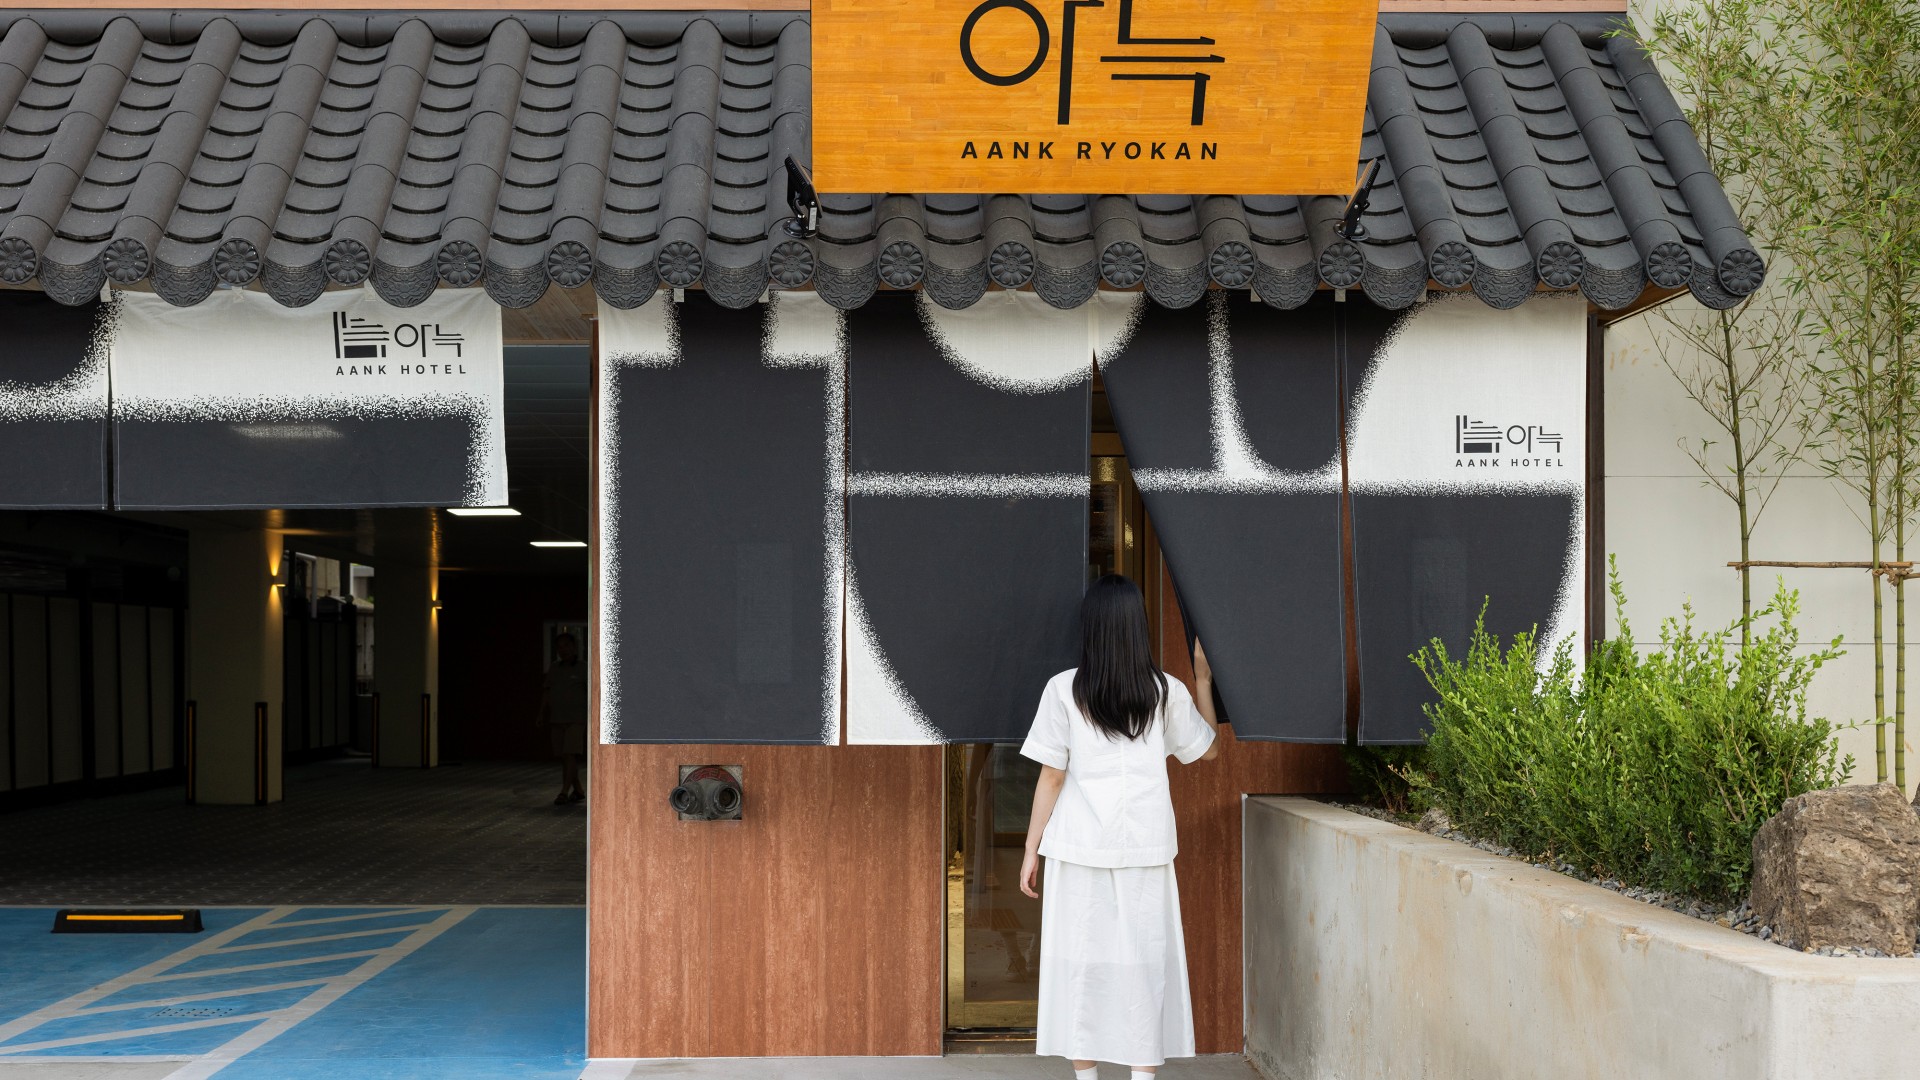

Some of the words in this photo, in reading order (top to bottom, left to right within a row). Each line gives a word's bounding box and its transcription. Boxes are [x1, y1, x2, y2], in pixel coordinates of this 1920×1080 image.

[960, 0, 1225, 125] 아늑
[961, 141, 1054, 160] AANK
[1077, 141, 1217, 160] RYOKAN
[336, 364, 387, 376] AANK
[400, 364, 466, 375] HOTEL
[1455, 458, 1500, 467] AANK
[1511, 458, 1563, 467] HOTEL
